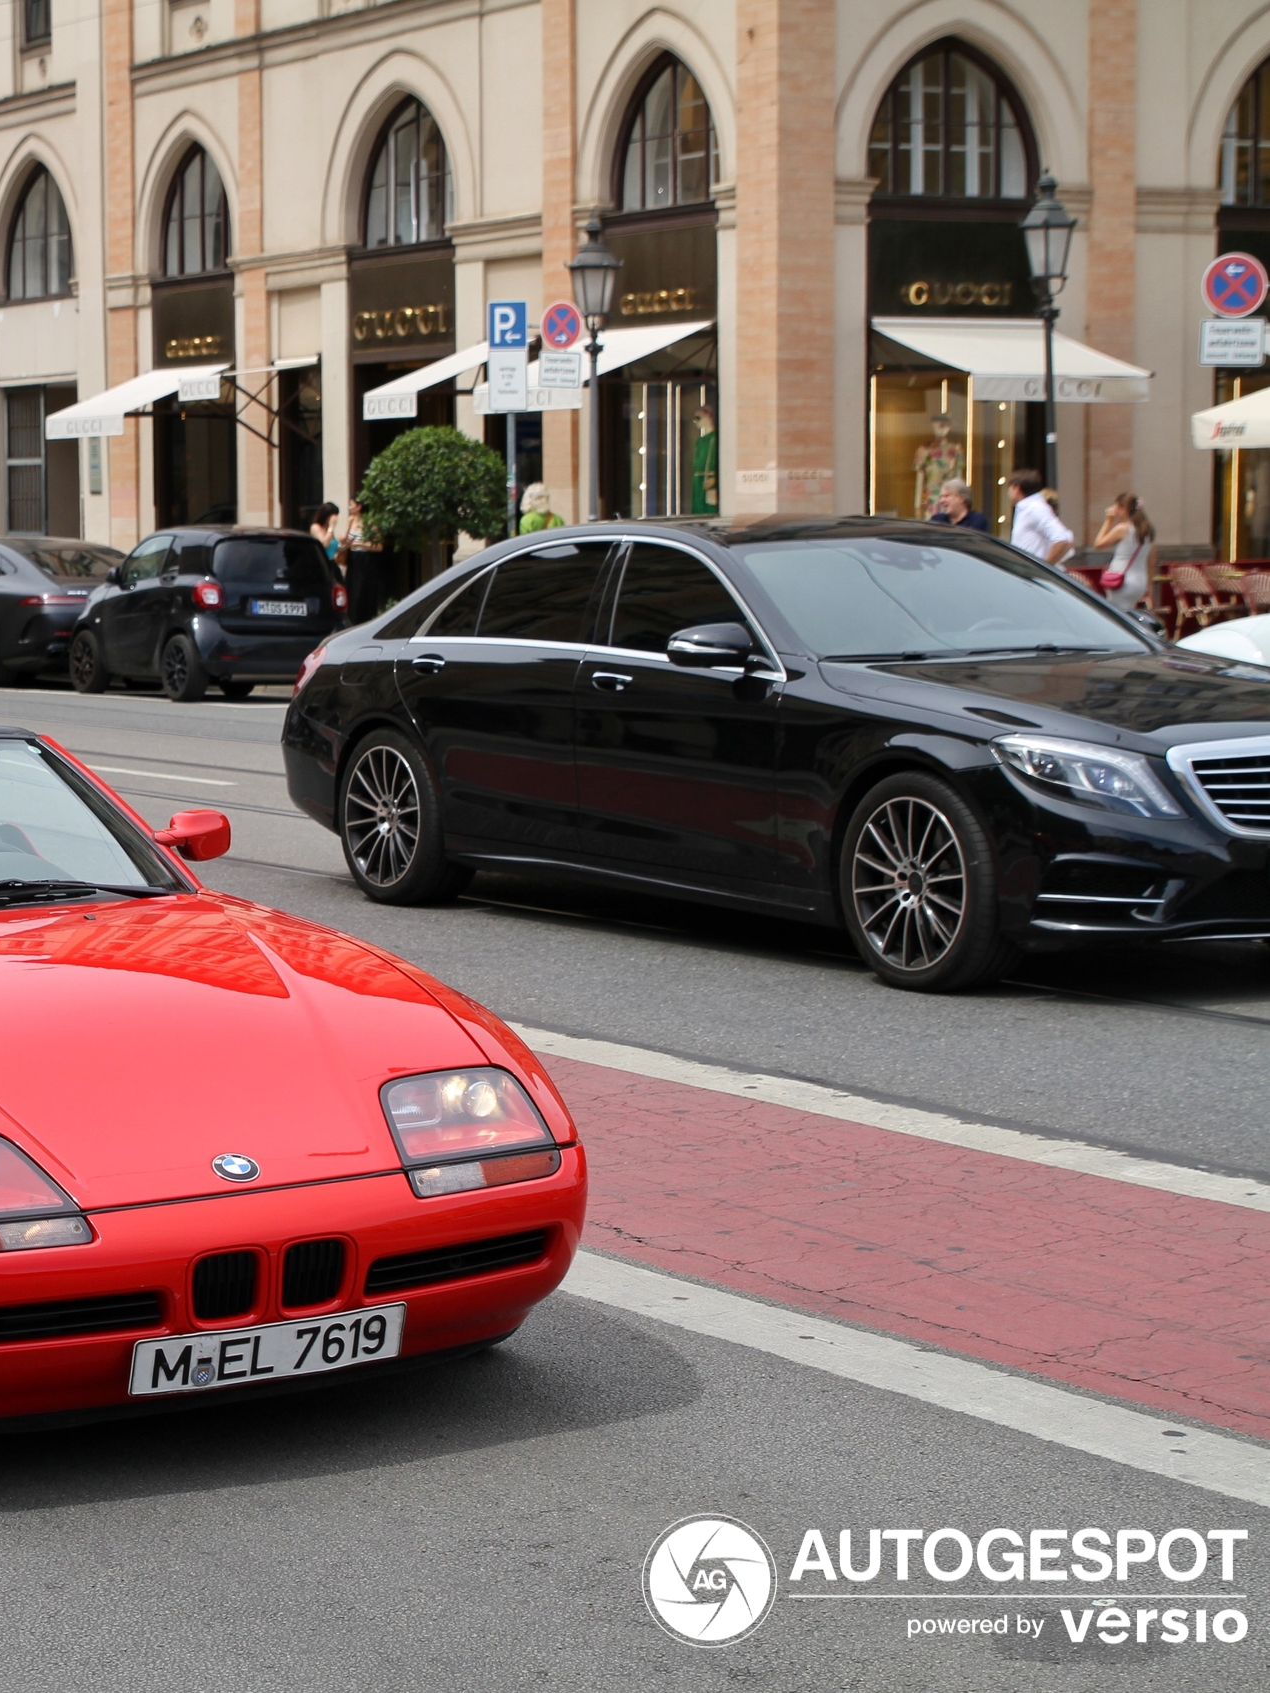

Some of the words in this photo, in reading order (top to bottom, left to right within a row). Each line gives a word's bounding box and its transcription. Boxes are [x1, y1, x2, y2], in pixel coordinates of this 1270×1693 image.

[620, 287, 697, 315] GUCCI
[908, 280, 1012, 306] GUCCI
[354, 302, 447, 340] GUCCI
[494, 306, 516, 344] P
[166, 334, 221, 358] GUCCI
[181, 380, 218, 397] GUCCI
[1023, 380, 1102, 398] GCCI
[367, 397, 414, 415] GUCCI
[66, 419, 103, 435] GUCCI
[293, 1314, 387, 1370] 7619
